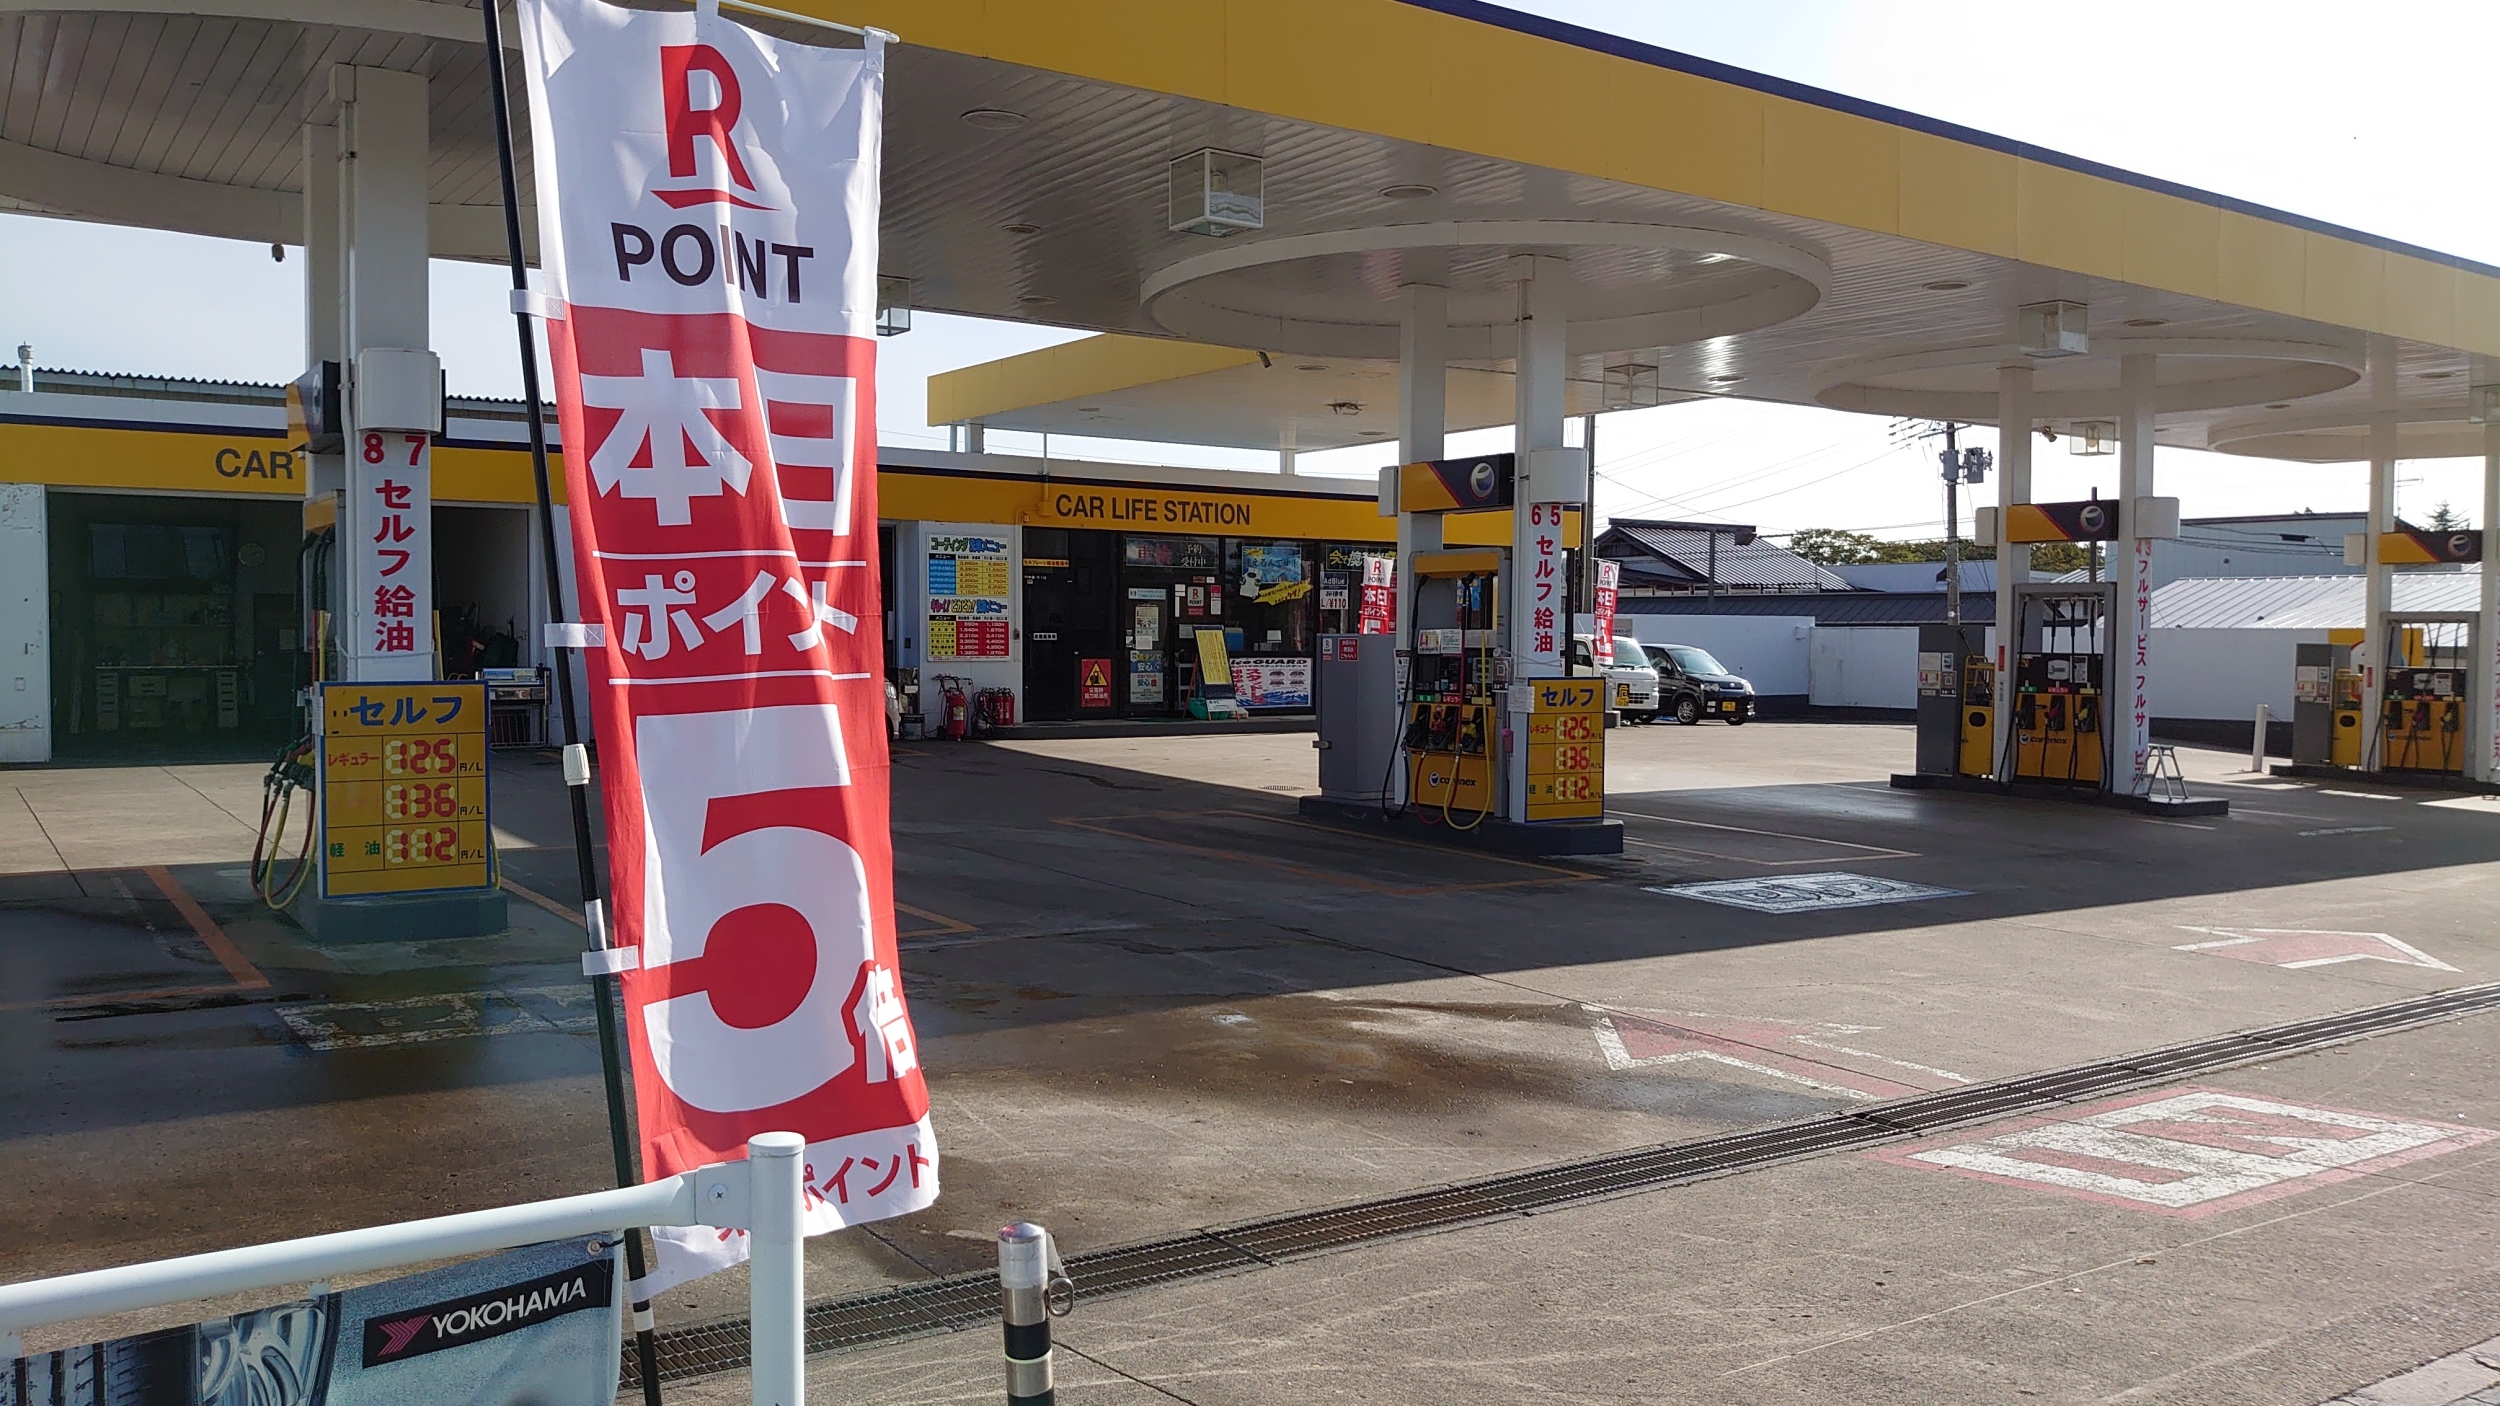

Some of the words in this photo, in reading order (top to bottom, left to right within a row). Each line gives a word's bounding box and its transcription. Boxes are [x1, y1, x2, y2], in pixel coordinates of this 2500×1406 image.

[660, 43, 757, 193] R
[610, 222, 814, 304] POINT
[363, 433, 385, 465] 8
[404, 435, 427, 466] 7
[580, 348, 858, 537] 本日
[214, 448, 294, 480] CAR
[1055, 493, 1105, 518] CAR
[1111, 497, 1158, 522] LIFE
[1163, 500, 1251, 526] STATION
[1531, 504, 1542, 526] 6
[1550, 504, 1561, 527] 5
[373, 478, 417, 652] セルフ給油
[1180, 556, 1207, 567] 受付中
[1373, 560, 1382, 573] R
[1323, 577, 1345, 585] AdBlue
[1364, 588, 1388, 606] 本日
[1533, 535, 1555, 653] セルフ給油
[1364, 607, 1388, 617] ポイント
[1597, 590, 1613, 606] 本日
[2136, 559, 2149, 667] フルサービス
[350, 696, 463, 727] セルフ
[1541, 686, 1595, 708] セルフ
[1529, 724, 1554, 735] レギュラー
[1563, 716, 1591, 740] 125
[327, 752, 380, 767] レギュラー
[399, 738, 457, 775] 125
[459, 761, 484, 772] 円/L
[1562, 746, 1590, 771] 136
[399, 783, 457, 819] 136
[459, 805, 484, 816] 円/L
[1562, 775, 1590, 801] 112
[400, 826, 457, 862] 112
[460, 849, 485, 859] 円/L
[636, 702, 874, 1113] 5
[857, 963, 918, 1084] 倍
[2000, 1105, 2384, 1185] IN
[431, 1276, 588, 1340] YOKOHAMA
